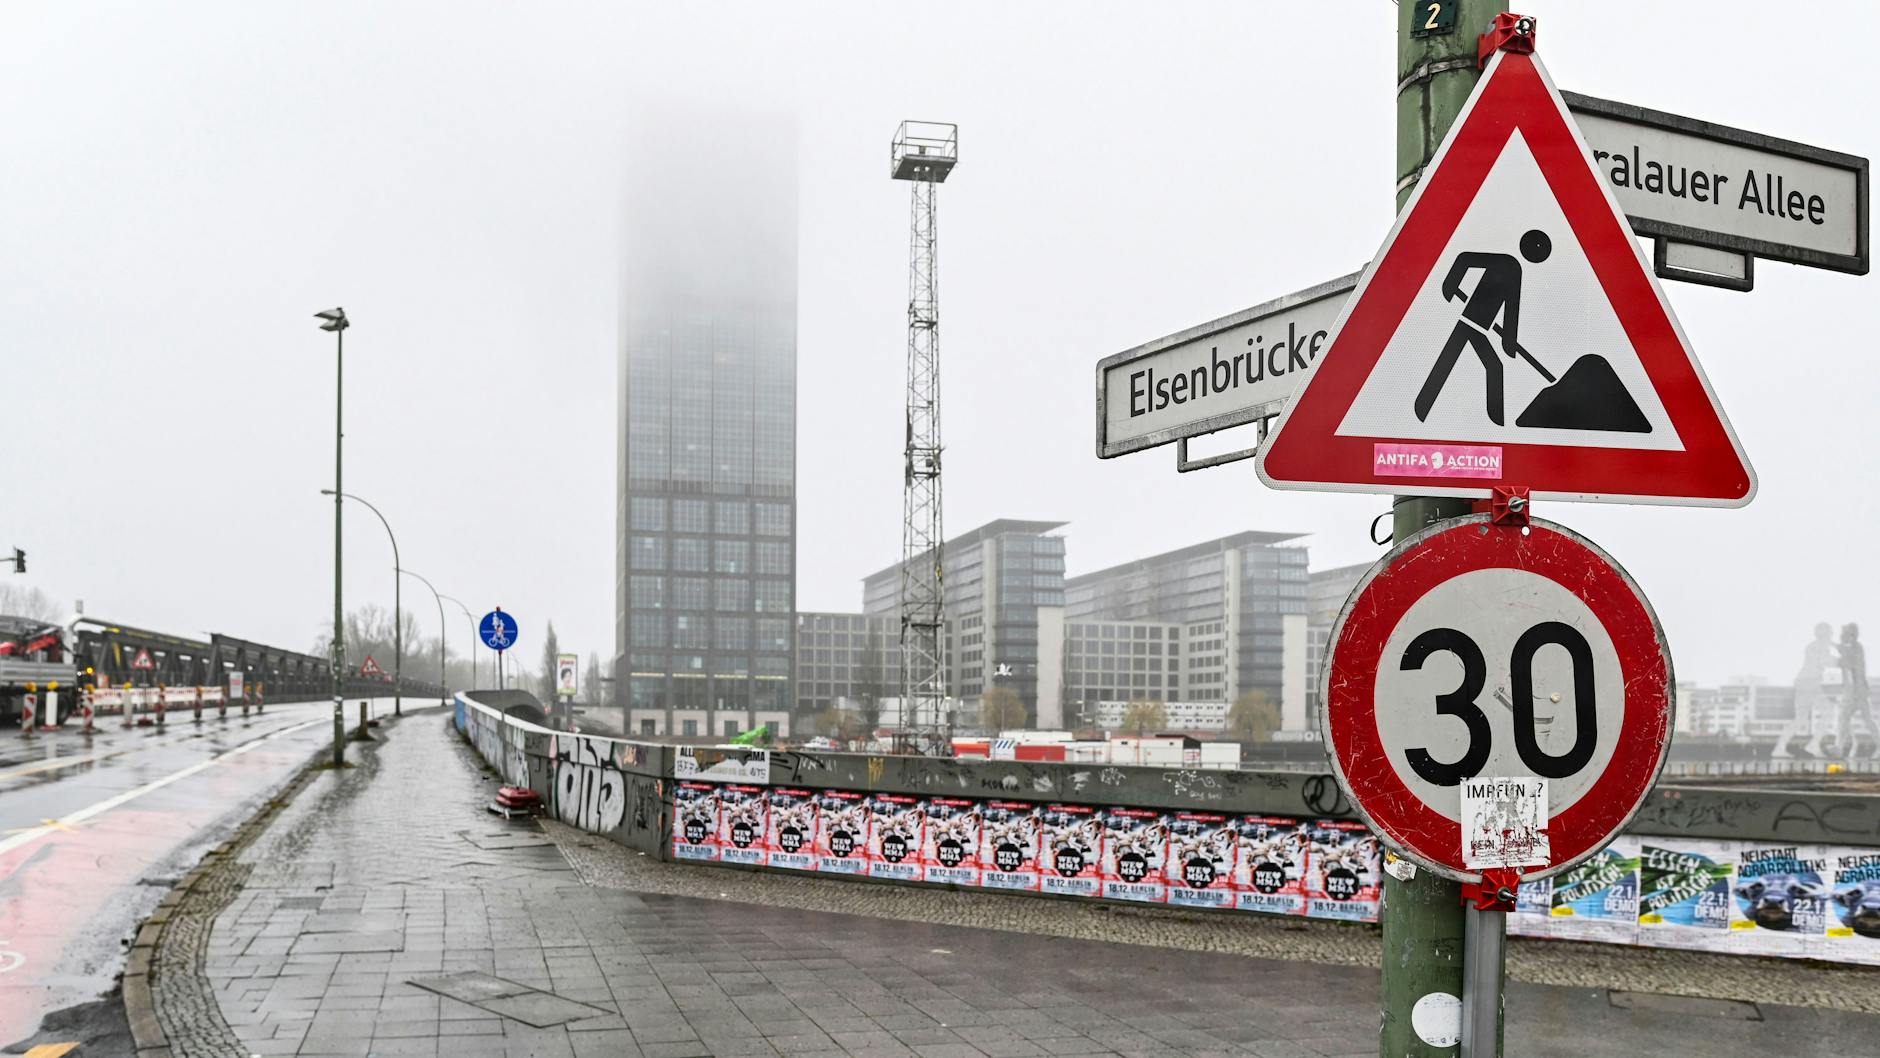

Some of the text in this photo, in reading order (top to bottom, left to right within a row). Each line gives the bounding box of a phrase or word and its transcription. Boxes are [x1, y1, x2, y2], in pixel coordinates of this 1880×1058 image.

[1424, 2, 1441, 30] 2
[1593, 146, 1825, 225] ralauer Allee
[1130, 322, 1328, 418] Elsenbrücke
[1376, 453, 1500, 468] ANTIFA ACTION
[1399, 621, 1598, 787] 30
[1648, 849, 1701, 874] ESSEN
[1741, 847, 1797, 863] NEUSTART
[1120, 868, 1144, 876] MMA
[1737, 858, 1827, 878] AGRARPOLITIK!
[1186, 873, 1211, 881] MMA
[1256, 878, 1282, 886] MMA
[1327, 884, 1354, 893] MMA
[1648, 868, 1716, 912] POLITISCH!
[1603, 898, 1636, 912] DEMO
[1694, 904, 1728, 920] DEMO
